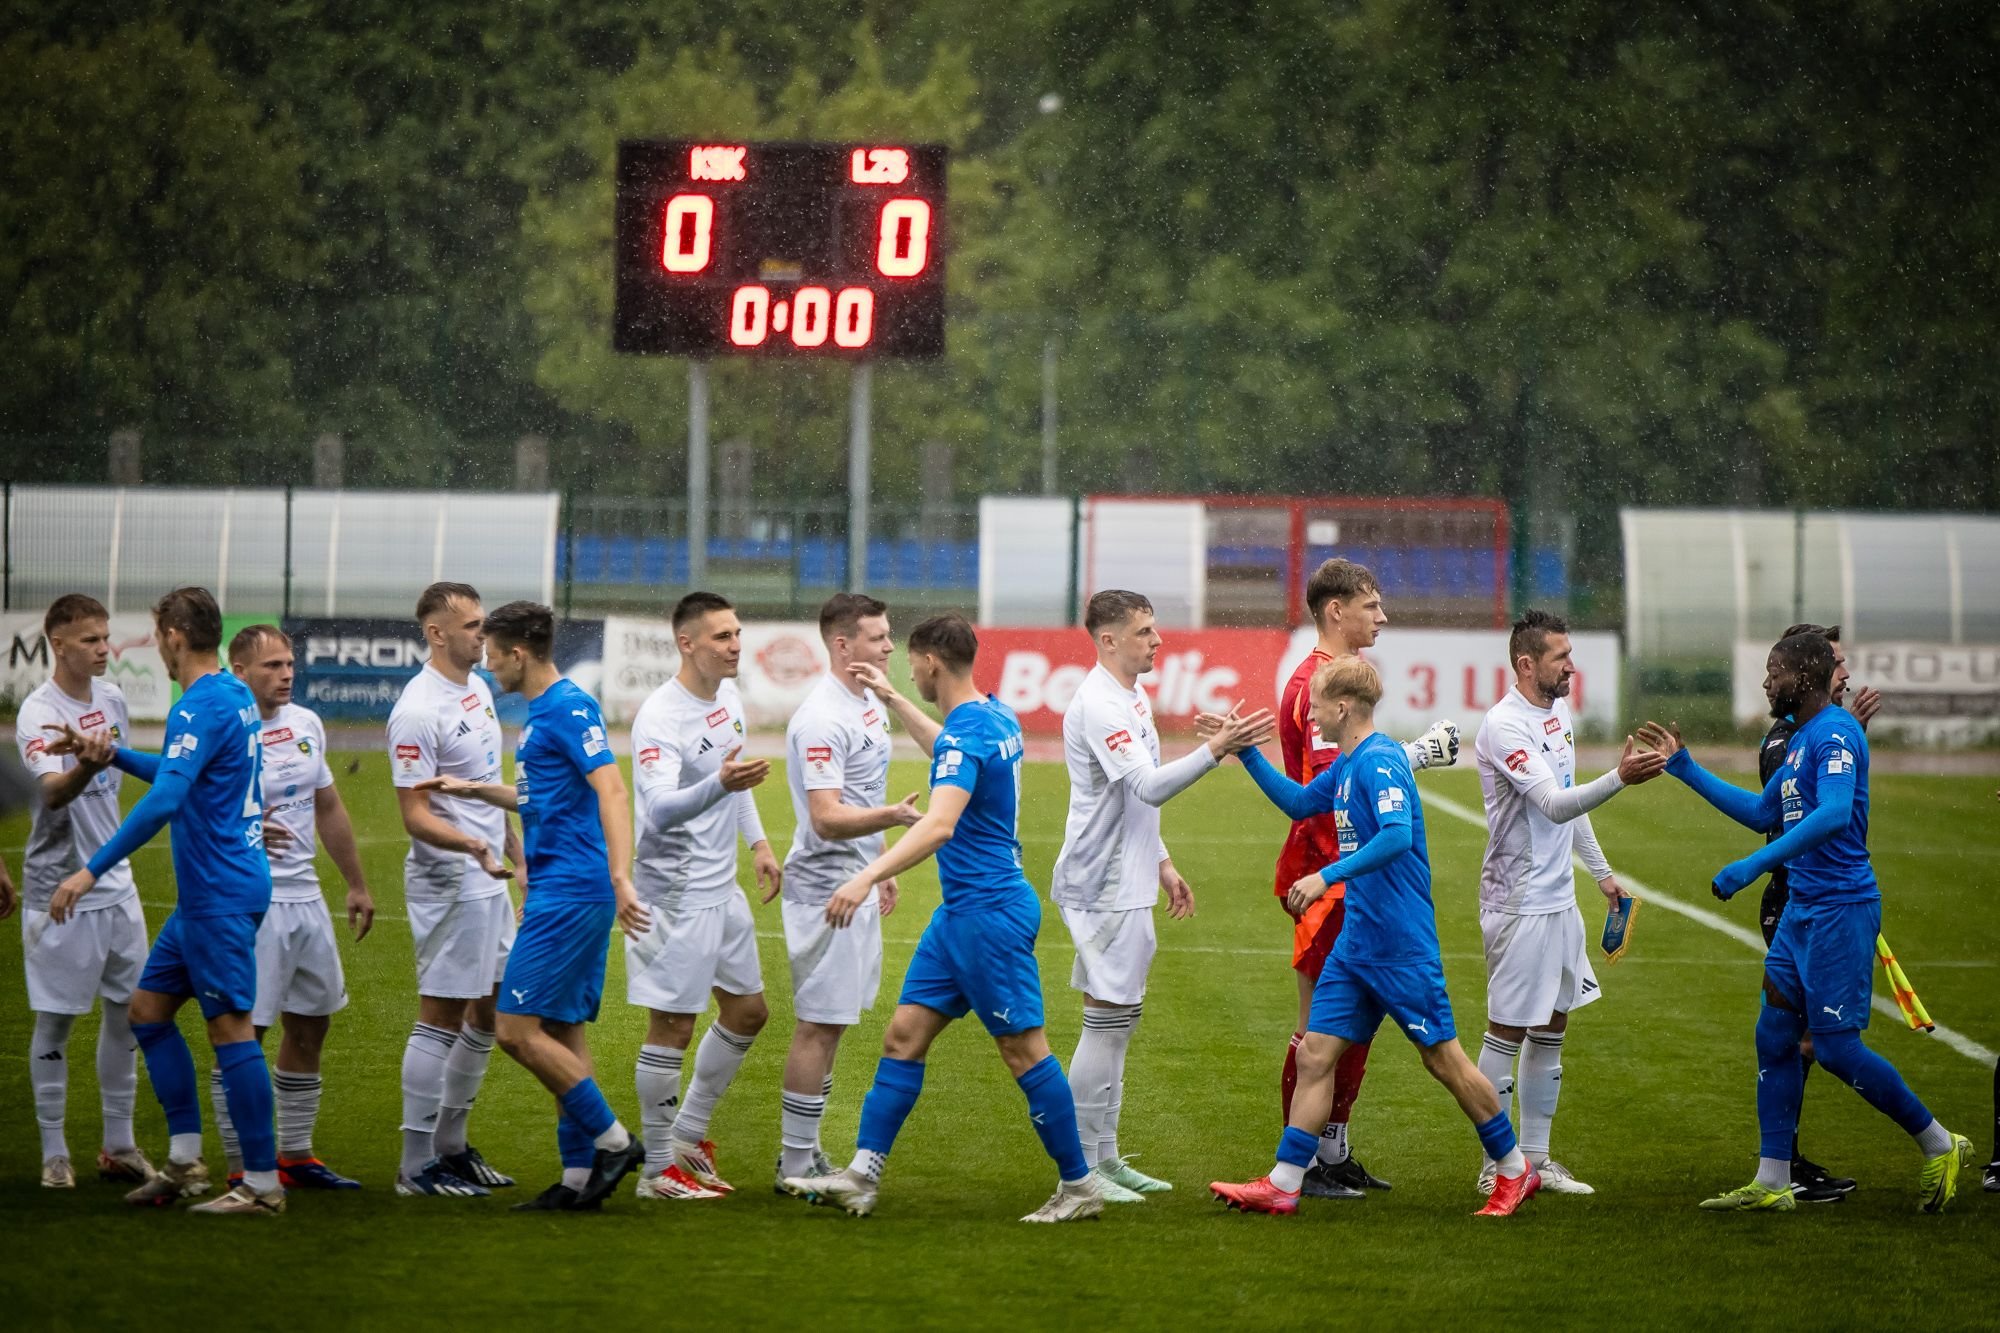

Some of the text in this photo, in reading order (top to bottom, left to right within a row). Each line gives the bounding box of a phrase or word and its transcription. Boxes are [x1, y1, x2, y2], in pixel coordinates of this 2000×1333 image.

[663, 194, 714, 273] 0
[876, 198, 931, 277] 0
[730, 285, 875, 348] 0:00
